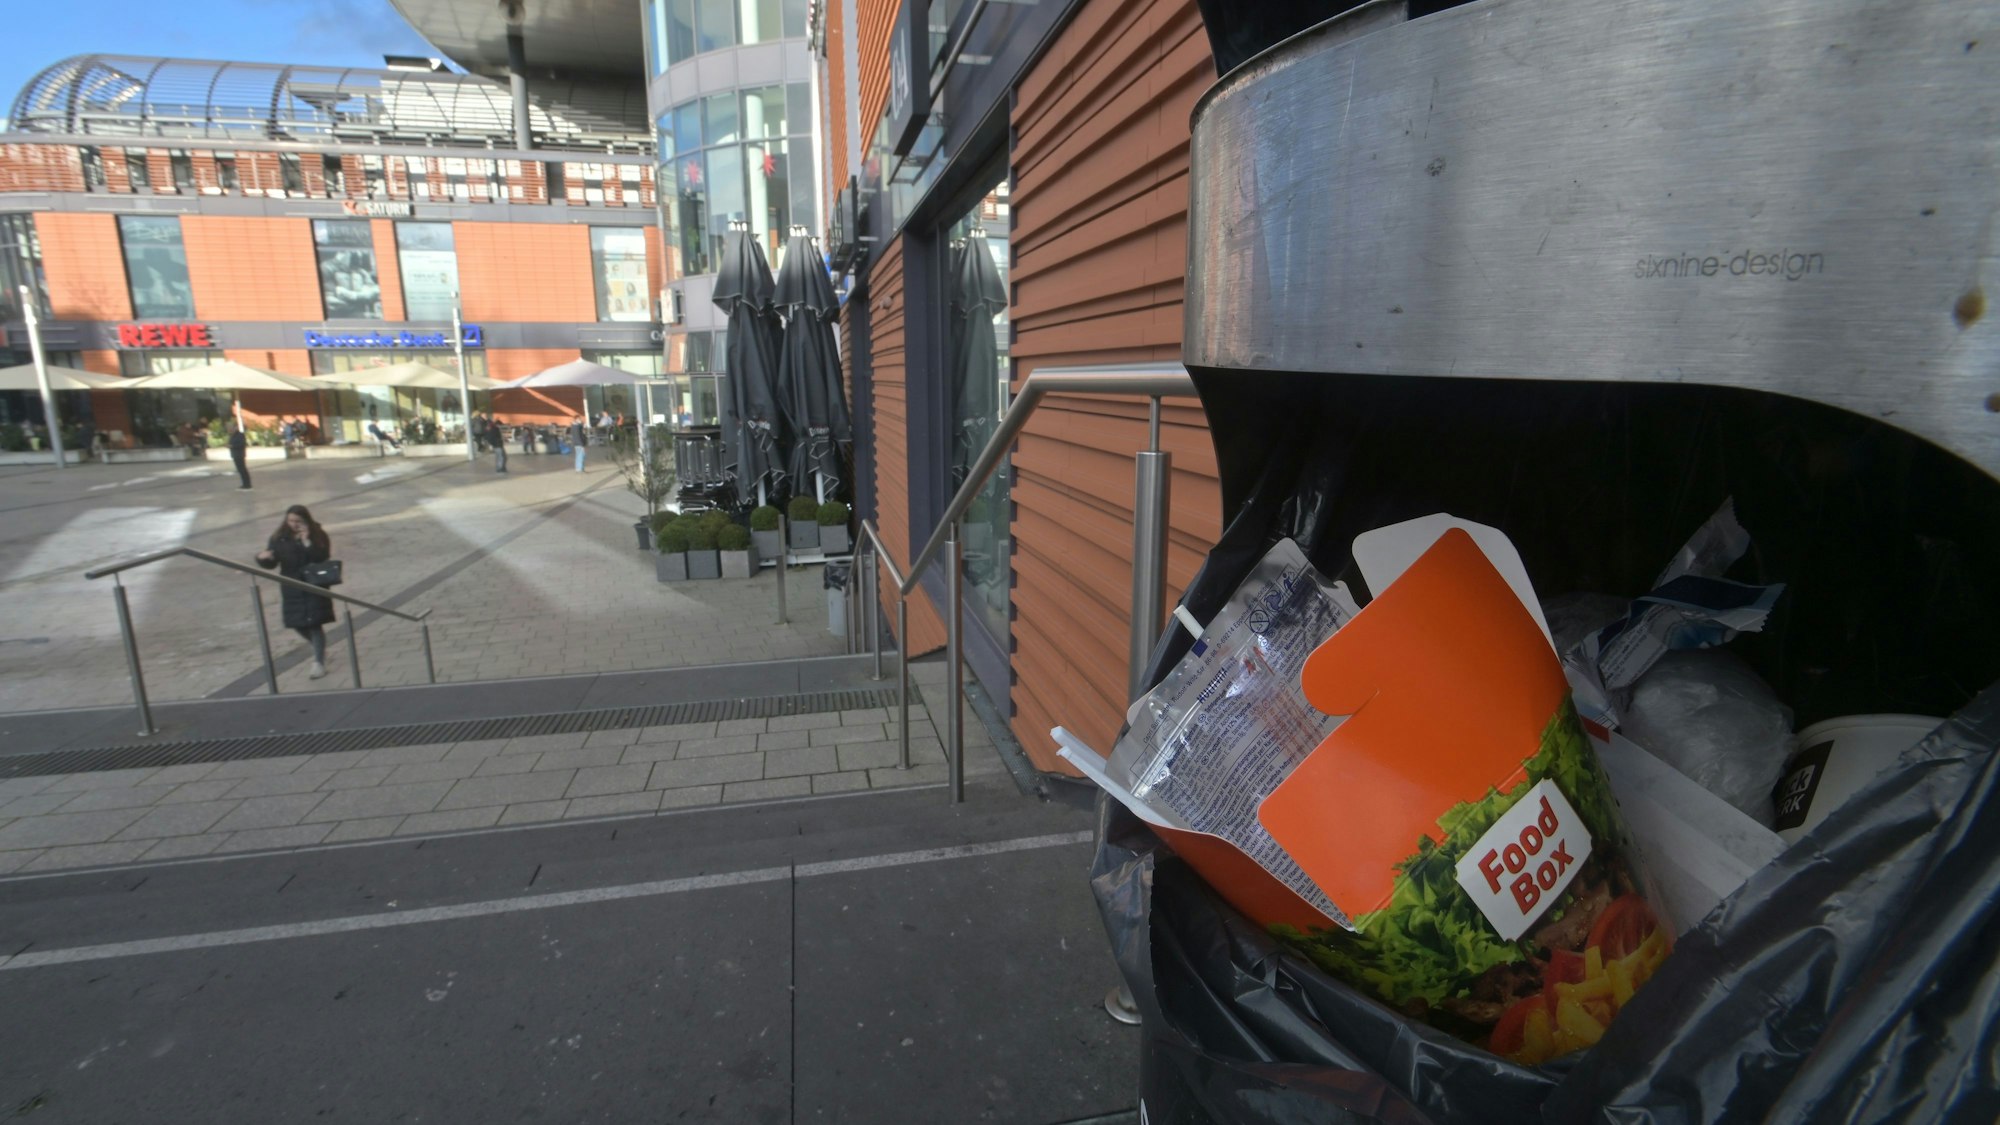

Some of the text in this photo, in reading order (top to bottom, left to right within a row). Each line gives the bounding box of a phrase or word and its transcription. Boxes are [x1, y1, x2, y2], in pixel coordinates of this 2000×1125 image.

[367, 202, 410, 216] SATURN
[1635, 248, 1824, 281] sixnine-design
[117, 323, 210, 347] REWE
[304, 329, 394, 348] Deutsche
[1478, 795, 1559, 895] Food
[1510, 839, 1574, 915] Box
